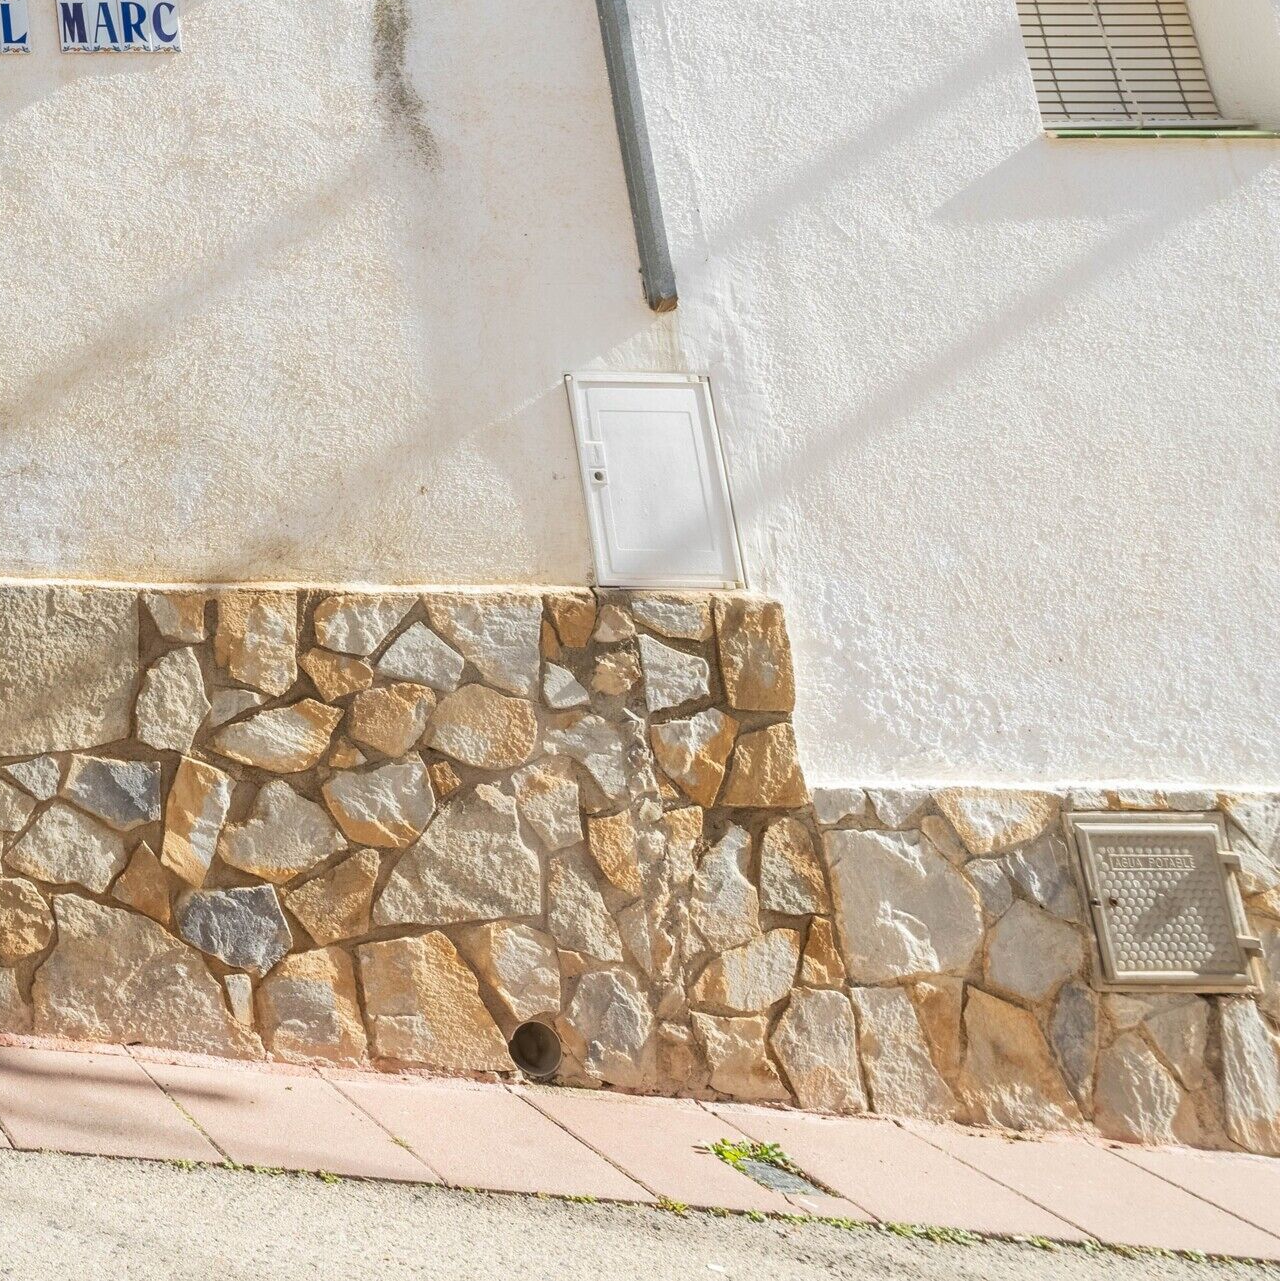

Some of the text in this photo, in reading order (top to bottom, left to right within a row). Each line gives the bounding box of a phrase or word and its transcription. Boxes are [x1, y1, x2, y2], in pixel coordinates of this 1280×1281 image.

[59, 1, 178, 44] MARC
[1115, 856, 1197, 869] AGUA POTABLE
